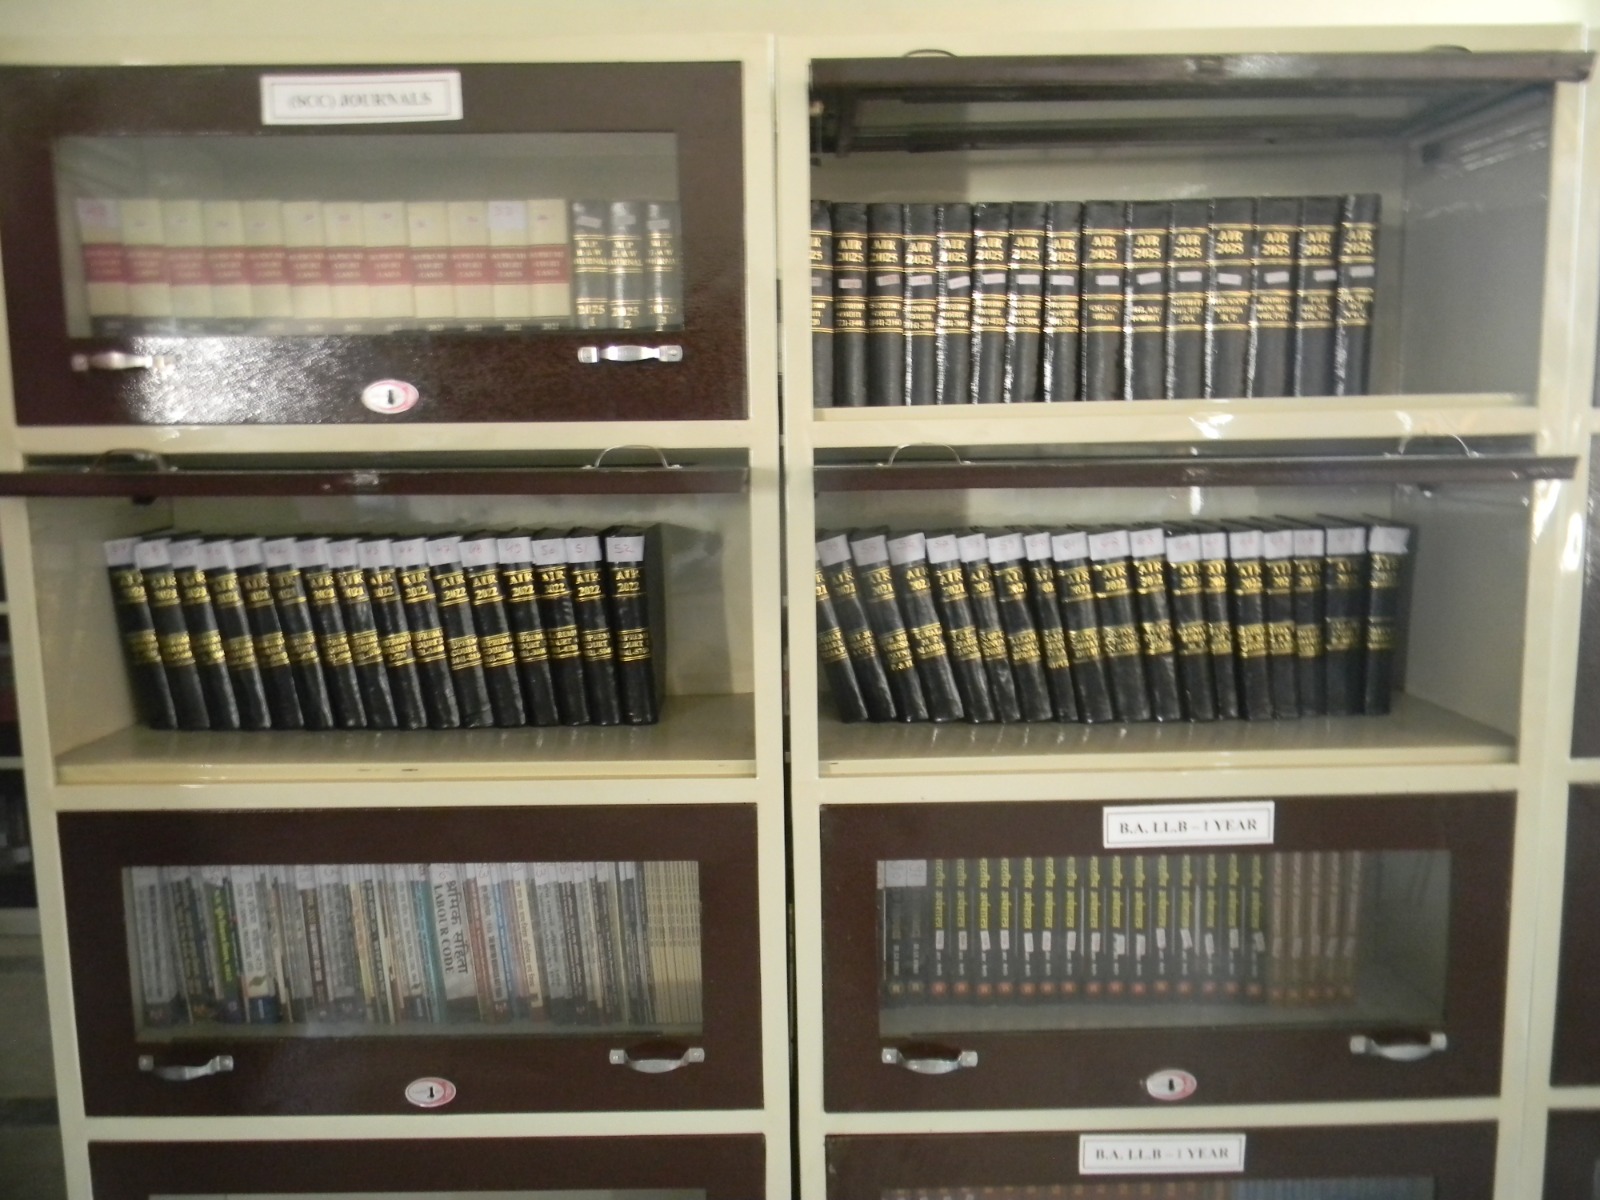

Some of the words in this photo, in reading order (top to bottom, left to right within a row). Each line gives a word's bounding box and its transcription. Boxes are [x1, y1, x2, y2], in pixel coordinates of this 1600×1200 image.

[340, 91, 432, 107] JOURNALS
[1091, 236, 1116, 247] AIR
[1135, 235, 1160, 246] AIR
[1176, 234, 1200, 245] AIR
[1218, 230, 1244, 242] AIR
[1264, 232, 1289, 243] AIR
[1306, 232, 1330, 243] AIR
[1346, 230, 1372, 241] AIR
[838, 240, 862, 250] AIR
[872, 240, 896, 250] AIR
[907, 242, 932, 252] AIR
[938, 239, 966, 250] AIR
[977, 237, 1002, 248] AIR
[1014, 237, 1038, 248] AIR
[1050, 238, 1075, 250] AIR
[1215, 242, 1244, 254] 2025
[1344, 242, 1373, 254] 2025
[612, 250, 638, 258] LAW
[939, 250, 968, 262] 2025
[976, 250, 1004, 260] 2025
[1012, 249, 1039, 260] 2025
[1089, 248, 1118, 260] 2025
[1133, 248, 1161, 258] 2025
[1174, 247, 1202, 258] 2025
[1261, 244, 1290, 256] 2025
[1304, 244, 1332, 256] 2025
[836, 252, 864, 262] 2025
[870, 253, 898, 262] 2025
[906, 254, 933, 265] 2025
[1049, 251, 1076, 262] 2025
[577, 304, 606, 315] 2025
[623, 320, 632, 328] 2
[1103, 566, 1126, 578] AIR
[1140, 561, 1162, 575] AIR
[370, 573, 394, 585] AIR
[402, 572, 427, 586] AIR
[441, 574, 466, 586] AIR
[509, 572, 534, 584] AIR
[542, 570, 566, 582] AIR
[576, 572, 600, 584] AIR
[616, 569, 640, 580] AIR
[940, 570, 962, 585] AIR
[472, 574, 498, 588] AIR
[405, 585, 428, 598] 2022
[444, 587, 467, 600] 2022
[474, 586, 499, 600] 2022
[512, 585, 535, 598] 2022
[578, 585, 602, 597] 2022
[618, 582, 640, 593] 2022
[1120, 822, 1148, 834] B.A.
[1152, 820, 1188, 834] LL.B
[1214, 818, 1258, 832] YEAR
[934, 890, 944, 928] अर्थशास्त्र
[979, 892, 990, 928] अर्थशास्त्र
[1000, 891, 1011, 928] अर्थशास्त्र
[1022, 892, 1034, 928] अर्थशास्त्र
[434, 884, 449, 936] LABOUR
[442, 940, 454, 973] CODE
[446, 880, 462, 925] श्रमिक
[454, 929, 469, 974] संहिता
[427, 1086, 435, 1098] 1
[1096, 1148, 1124, 1160] B.A.
[1128, 1148, 1162, 1160] LL.B
[1187, 1147, 1229, 1159] YEAR
